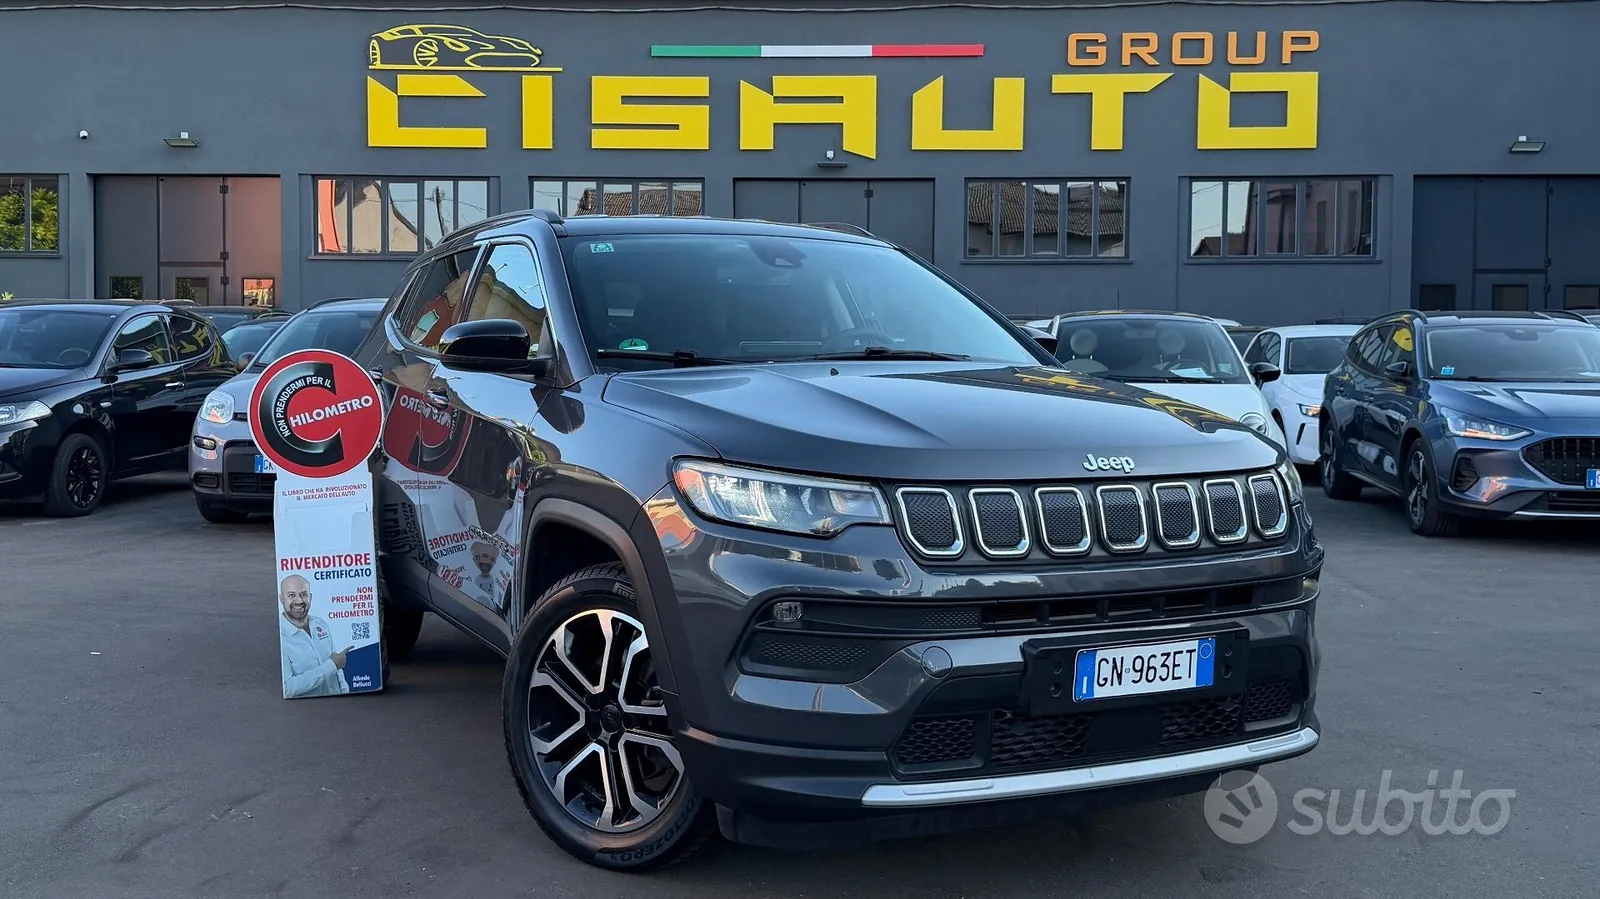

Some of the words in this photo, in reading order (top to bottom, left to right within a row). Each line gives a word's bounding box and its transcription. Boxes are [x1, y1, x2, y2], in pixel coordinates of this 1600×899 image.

[1066, 30, 1320, 66] GROUP
[367, 71, 1319, 160] CISAUTO
[306, 376, 324, 386] PER
[324, 378, 332, 388] IL
[275, 378, 306, 418] PRENDERMI
[277, 420, 291, 438] NON
[1082, 453, 1135, 474] Jeep
[325, 483, 368, 492] RIVOLUZIONATO
[303, 492, 328, 500] MERCATO
[329, 490, 356, 499] DELL'AUTO
[280, 553, 371, 571] RIVENDITORE
[314, 568, 372, 581] CERTIFICATO
[356, 586, 373, 594] NON
[331, 593, 374, 603] PRENDERMI
[328, 609, 375, 619] CHILOMETRO
[352, 674, 370, 682] Alfredo
